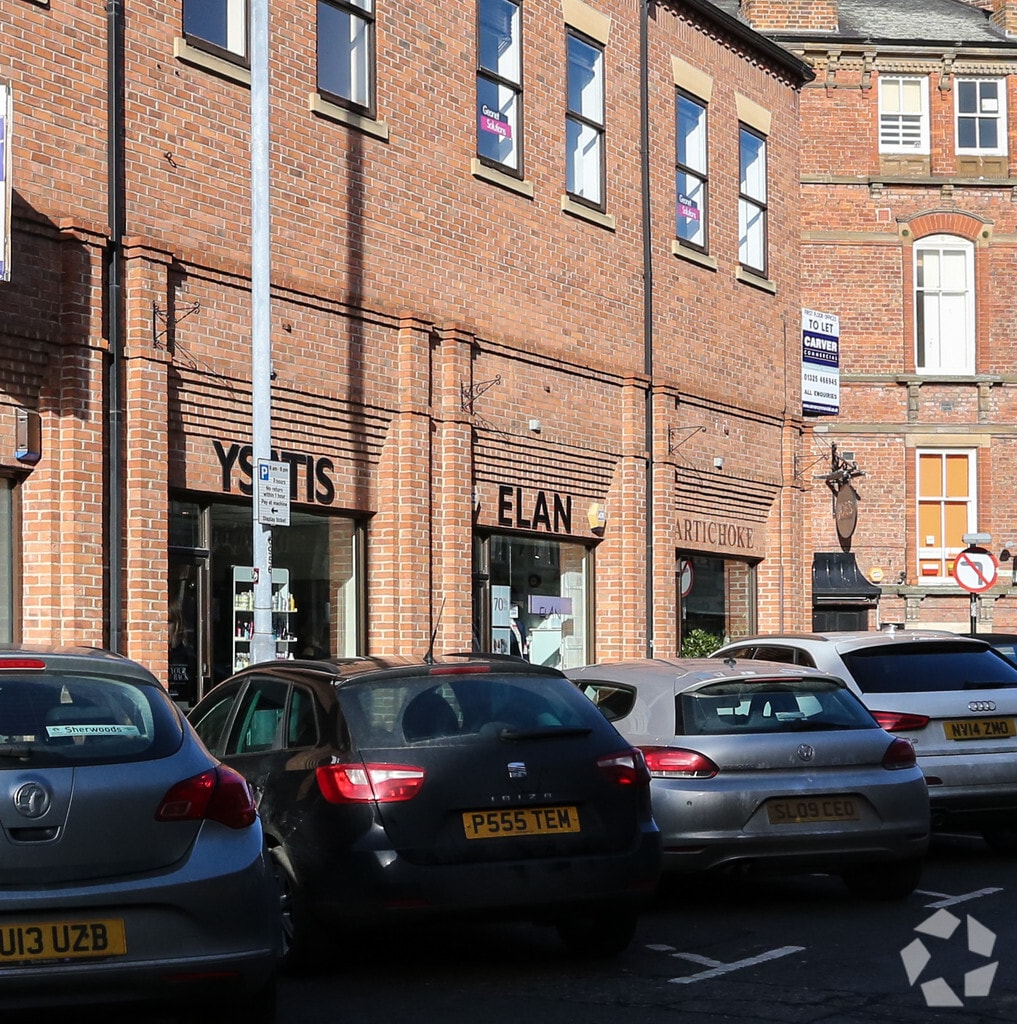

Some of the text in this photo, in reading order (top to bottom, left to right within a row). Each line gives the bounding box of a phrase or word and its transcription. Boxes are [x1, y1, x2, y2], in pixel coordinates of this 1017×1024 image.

[808, 319, 833, 333] TO LET
[804, 336, 837, 352] CARVER
[814, 390, 837, 400] ENQUIRIES
[212, 440, 335, 505] YSTIS
[498, 486, 571, 534] ELAN
[675, 518, 754, 549] ARTICHOKE
[472, 809, 571, 834] P555 TEM
[52, 923, 108, 953] UZB
